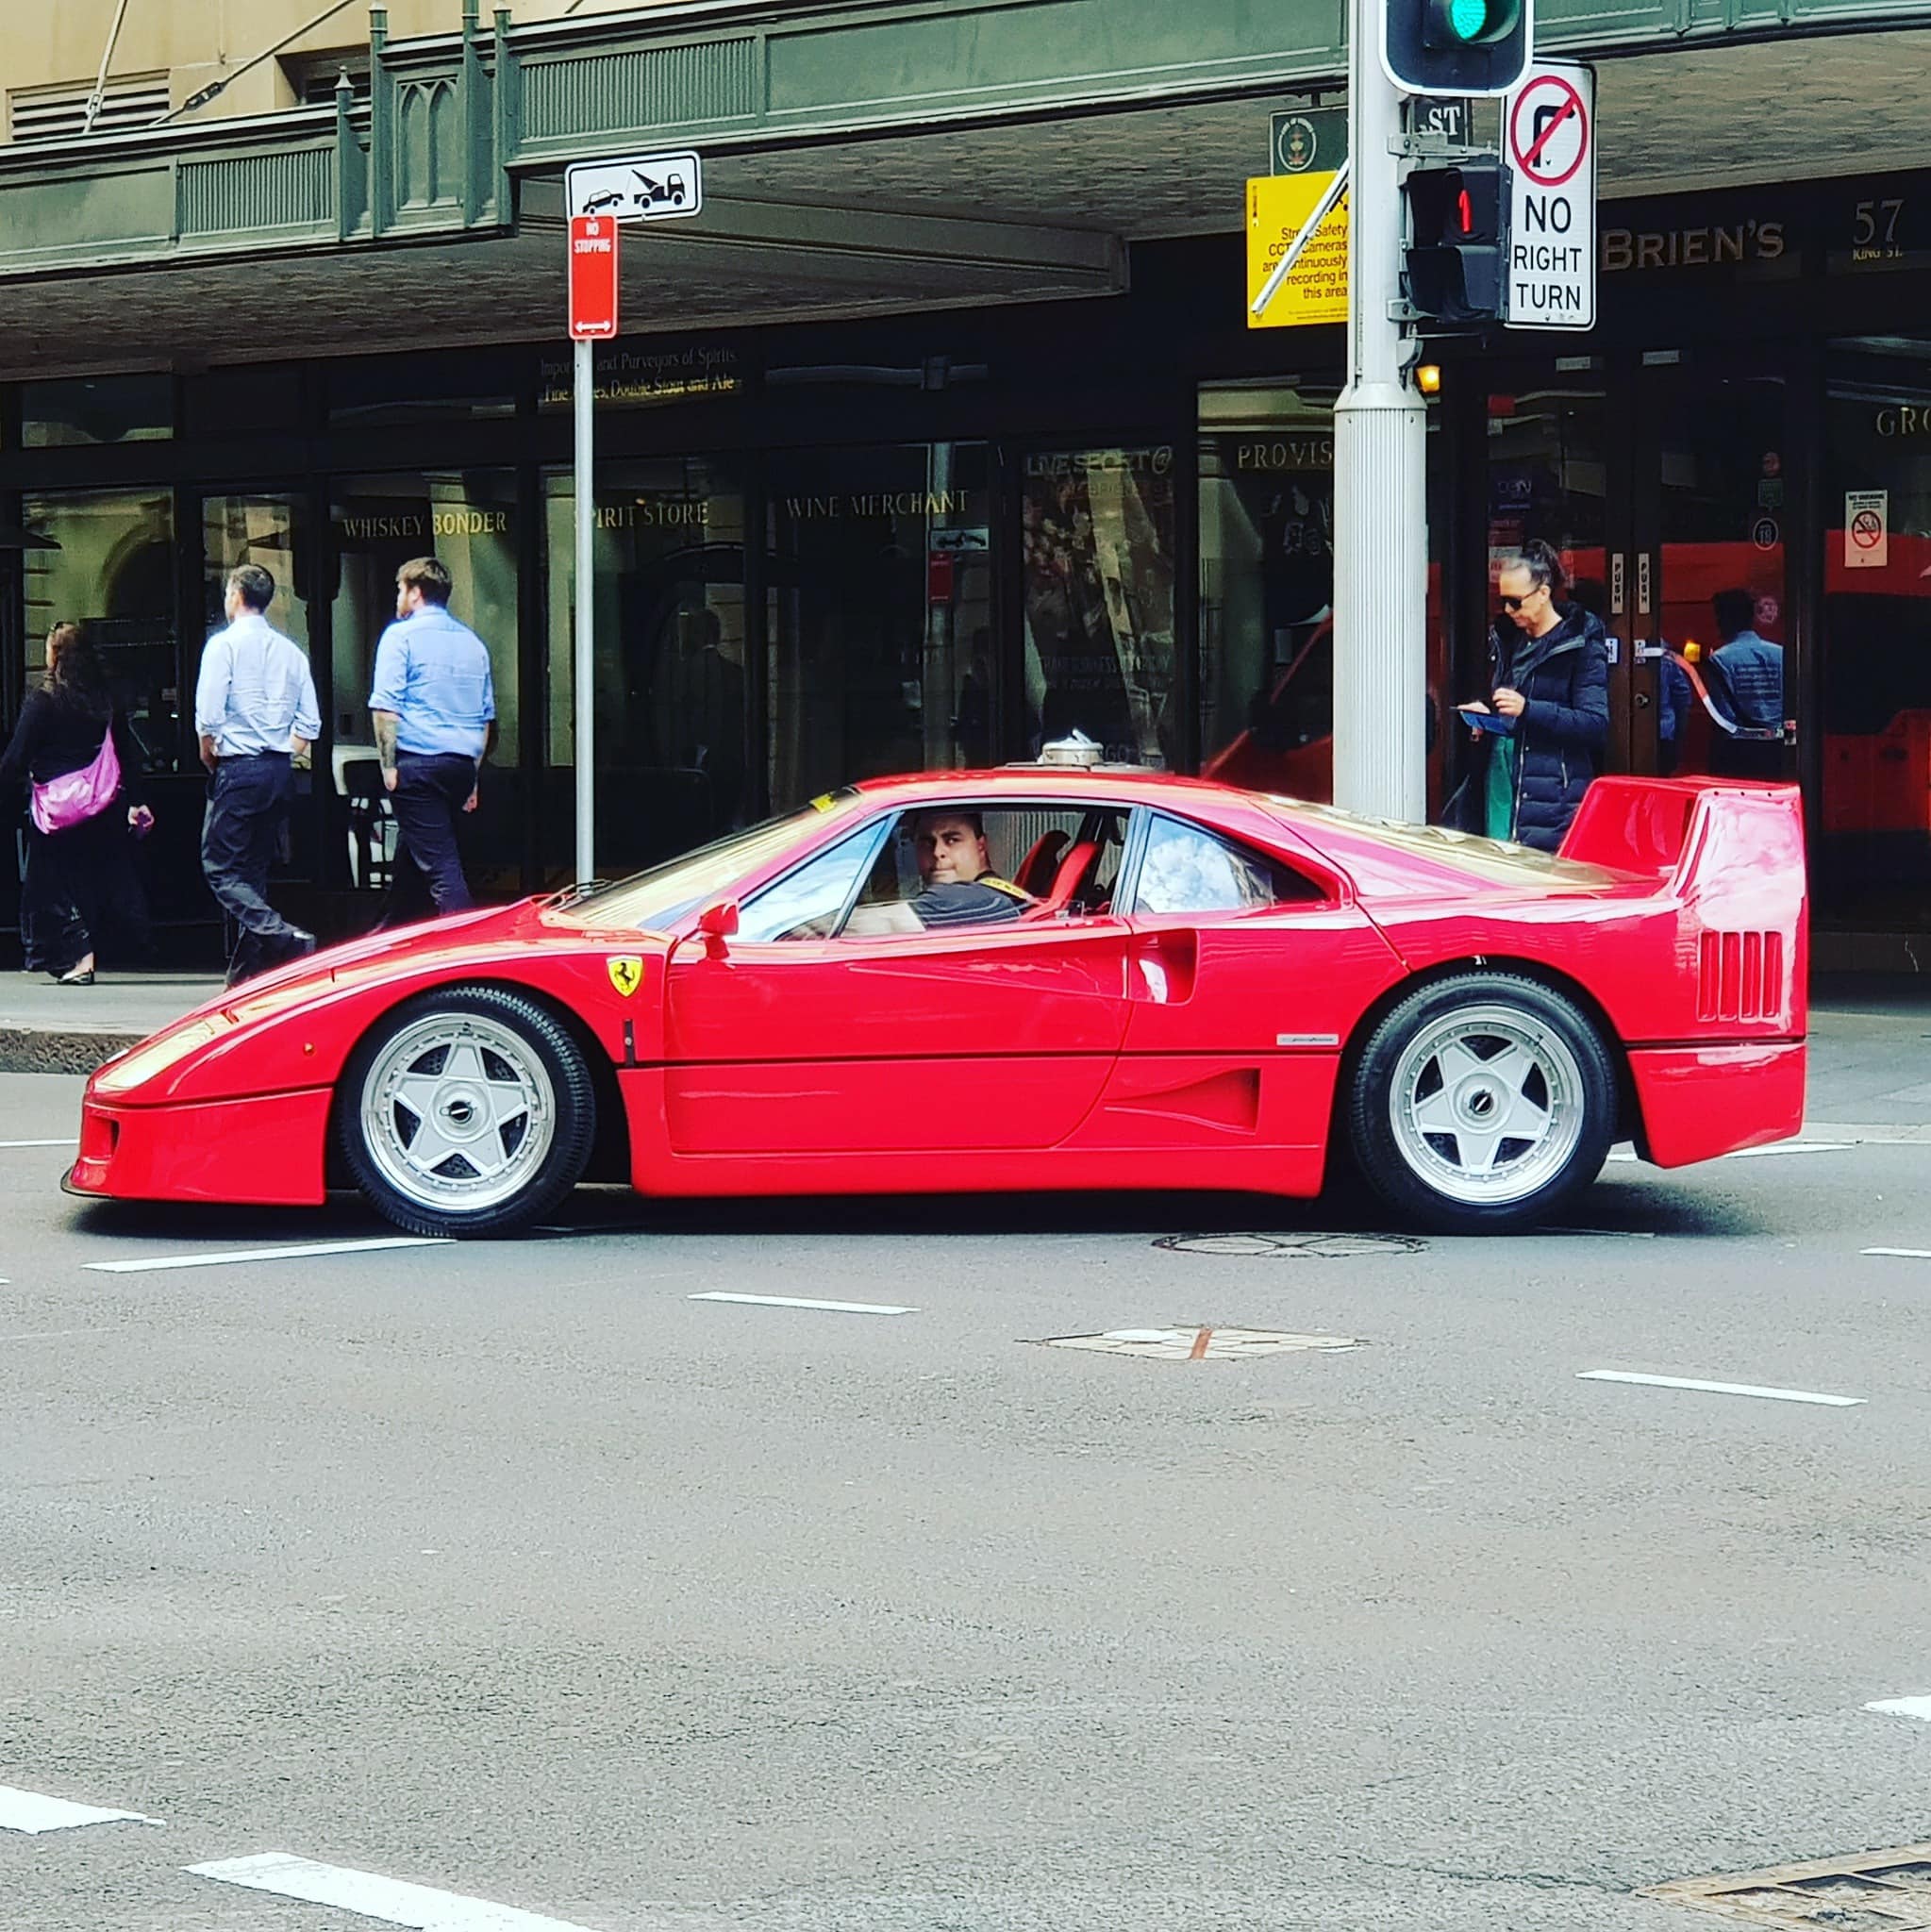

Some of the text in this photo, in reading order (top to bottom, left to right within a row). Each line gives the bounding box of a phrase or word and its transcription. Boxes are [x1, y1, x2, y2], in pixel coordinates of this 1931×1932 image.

[1429, 106, 1460, 136] ST
[1525, 195, 1571, 233] NO
[1853, 199, 1905, 244] 57
[586, 222, 599, 236] NO
[1315, 223, 1348, 238] Safety
[574, 239, 611, 254] STOPPING
[1269, 242, 1292, 257] CCT
[1514, 245, 1582, 273] RIGHT
[1290, 255, 1348, 272] ntinuously
[1287, 271, 1348, 286] recording in
[1303, 287, 1322, 299] this
[1516, 283, 1580, 310] TURN
[620, 351, 681, 375] Purveyors
[1238, 441, 1332, 469] PROVIS
[593, 501, 709, 529] IRIT STORE
[786, 490, 969, 518] WINE MERCHANT
[343, 511, 507, 539] WHISKEY BONDER
